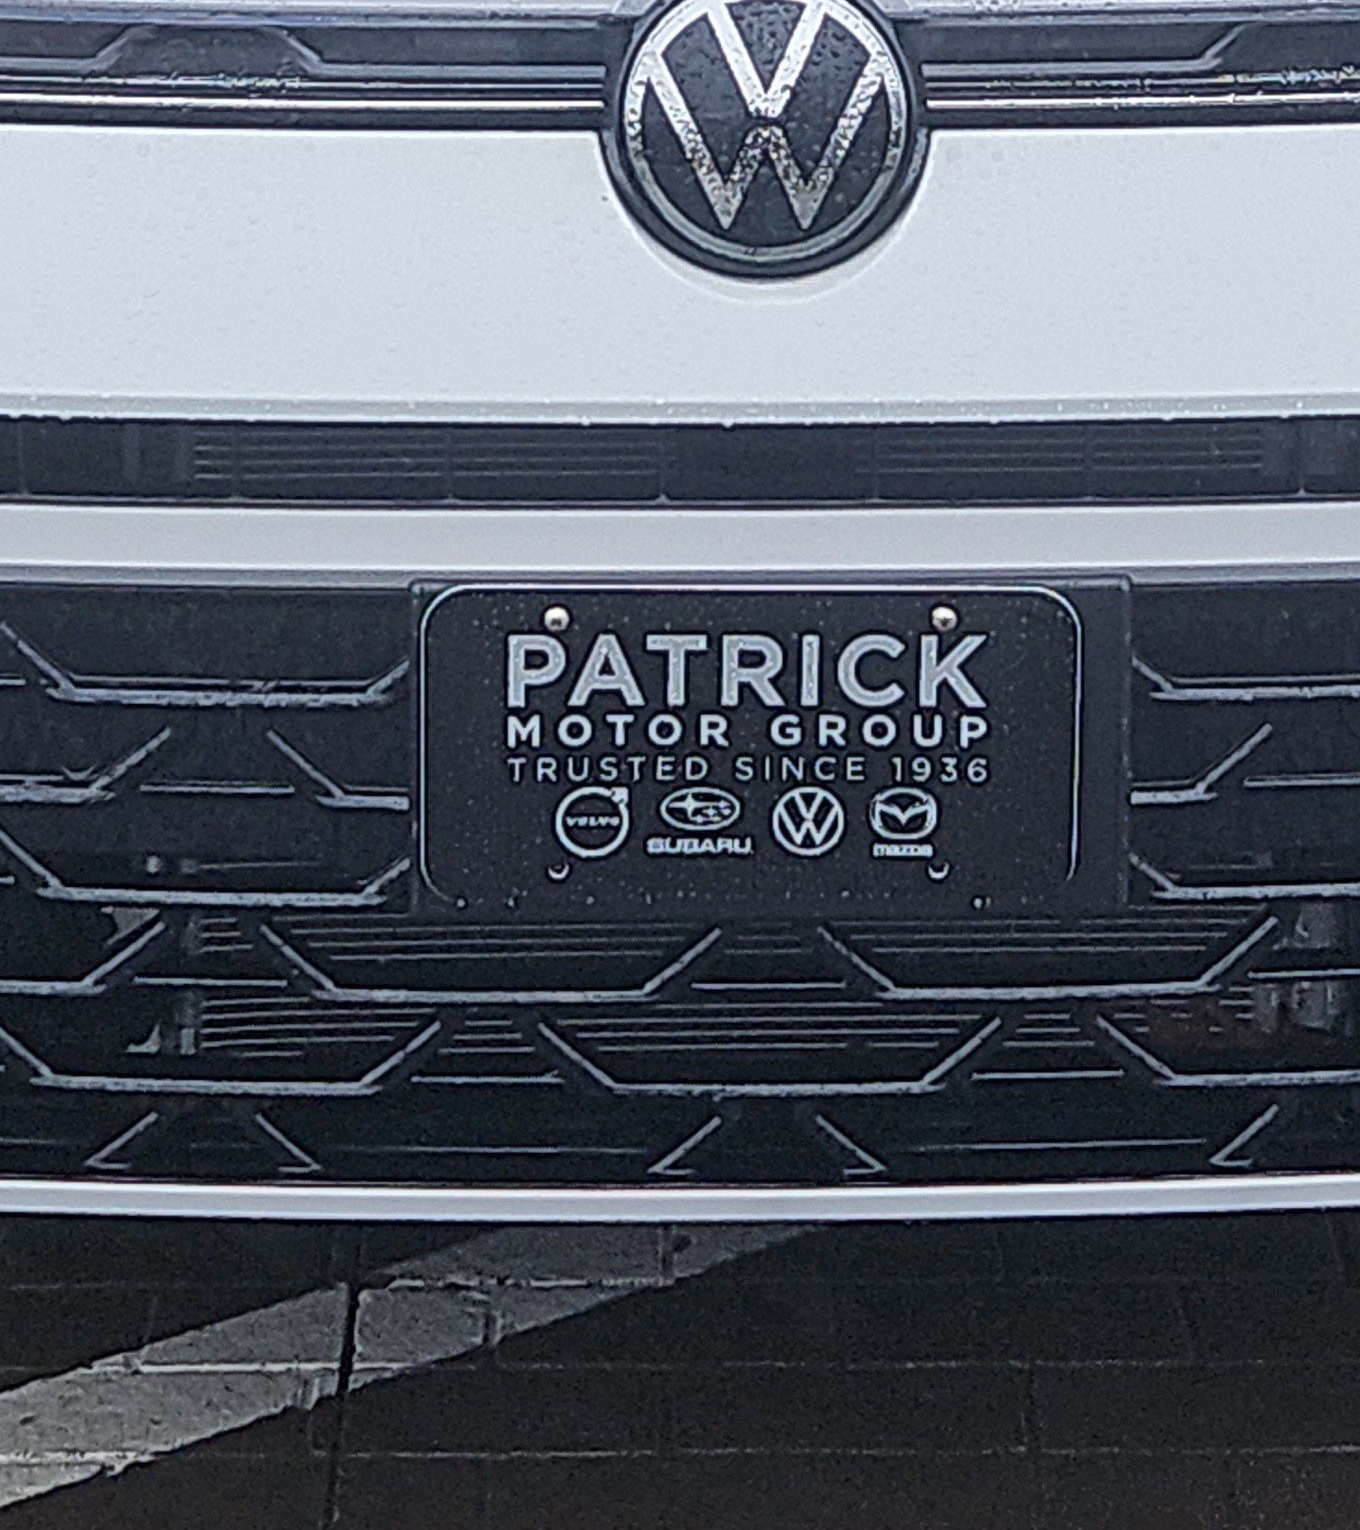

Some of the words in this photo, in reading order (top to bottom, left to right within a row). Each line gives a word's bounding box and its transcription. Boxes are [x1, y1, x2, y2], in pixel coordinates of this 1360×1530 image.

[508, 635, 986, 707] PATRICK
[508, 715, 728, 747] MOTOR
[771, 715, 986, 748] GROUP
[508, 756, 707, 781] TRUSTED
[736, 757, 864, 780] SINCE
[893, 758, 986, 781] 1936
[647, 838, 751, 853] SUBARU
